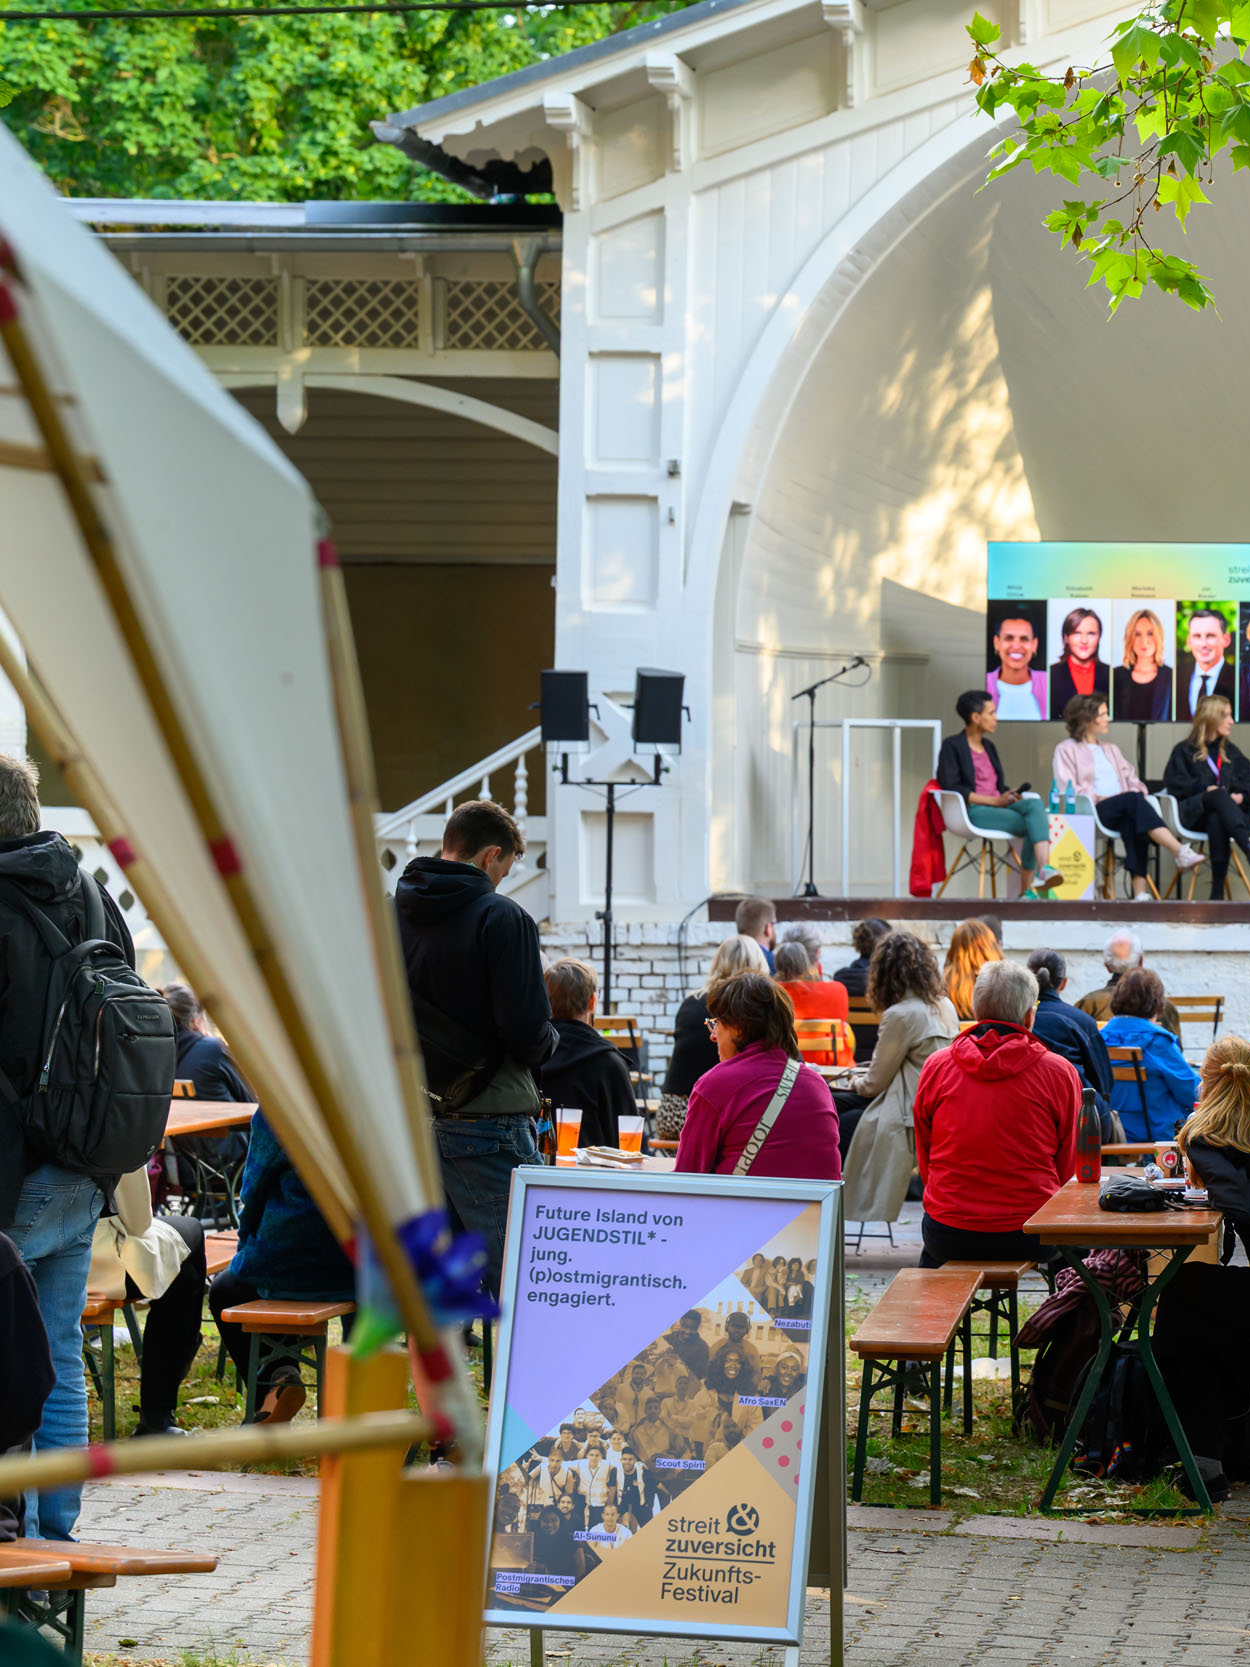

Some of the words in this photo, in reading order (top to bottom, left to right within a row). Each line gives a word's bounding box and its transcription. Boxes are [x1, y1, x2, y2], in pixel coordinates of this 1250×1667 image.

[736, 1117, 772, 1173] JOOP!
[535, 1205, 591, 1222] Future
[596, 1208, 648, 1224] Island
[652, 1214, 684, 1227] von
[529, 1246, 573, 1265] jung.
[528, 1267, 688, 1290] (p)ostmigrantisch.
[526, 1291, 616, 1308] engagiert.
[739, 1397, 757, 1405] Afro
[758, 1398, 787, 1407] SaxEN
[656, 1459, 681, 1468] Scout
[682, 1460, 706, 1470] Spirit
[667, 1516, 721, 1535] streit
[665, 1538, 776, 1558] zuversicht
[496, 1573, 575, 1585] Postmigrantisches
[662, 1561, 762, 1584] Zukunfts-
[495, 1584, 520, 1592] Radio
[661, 1581, 739, 1604] Festival
